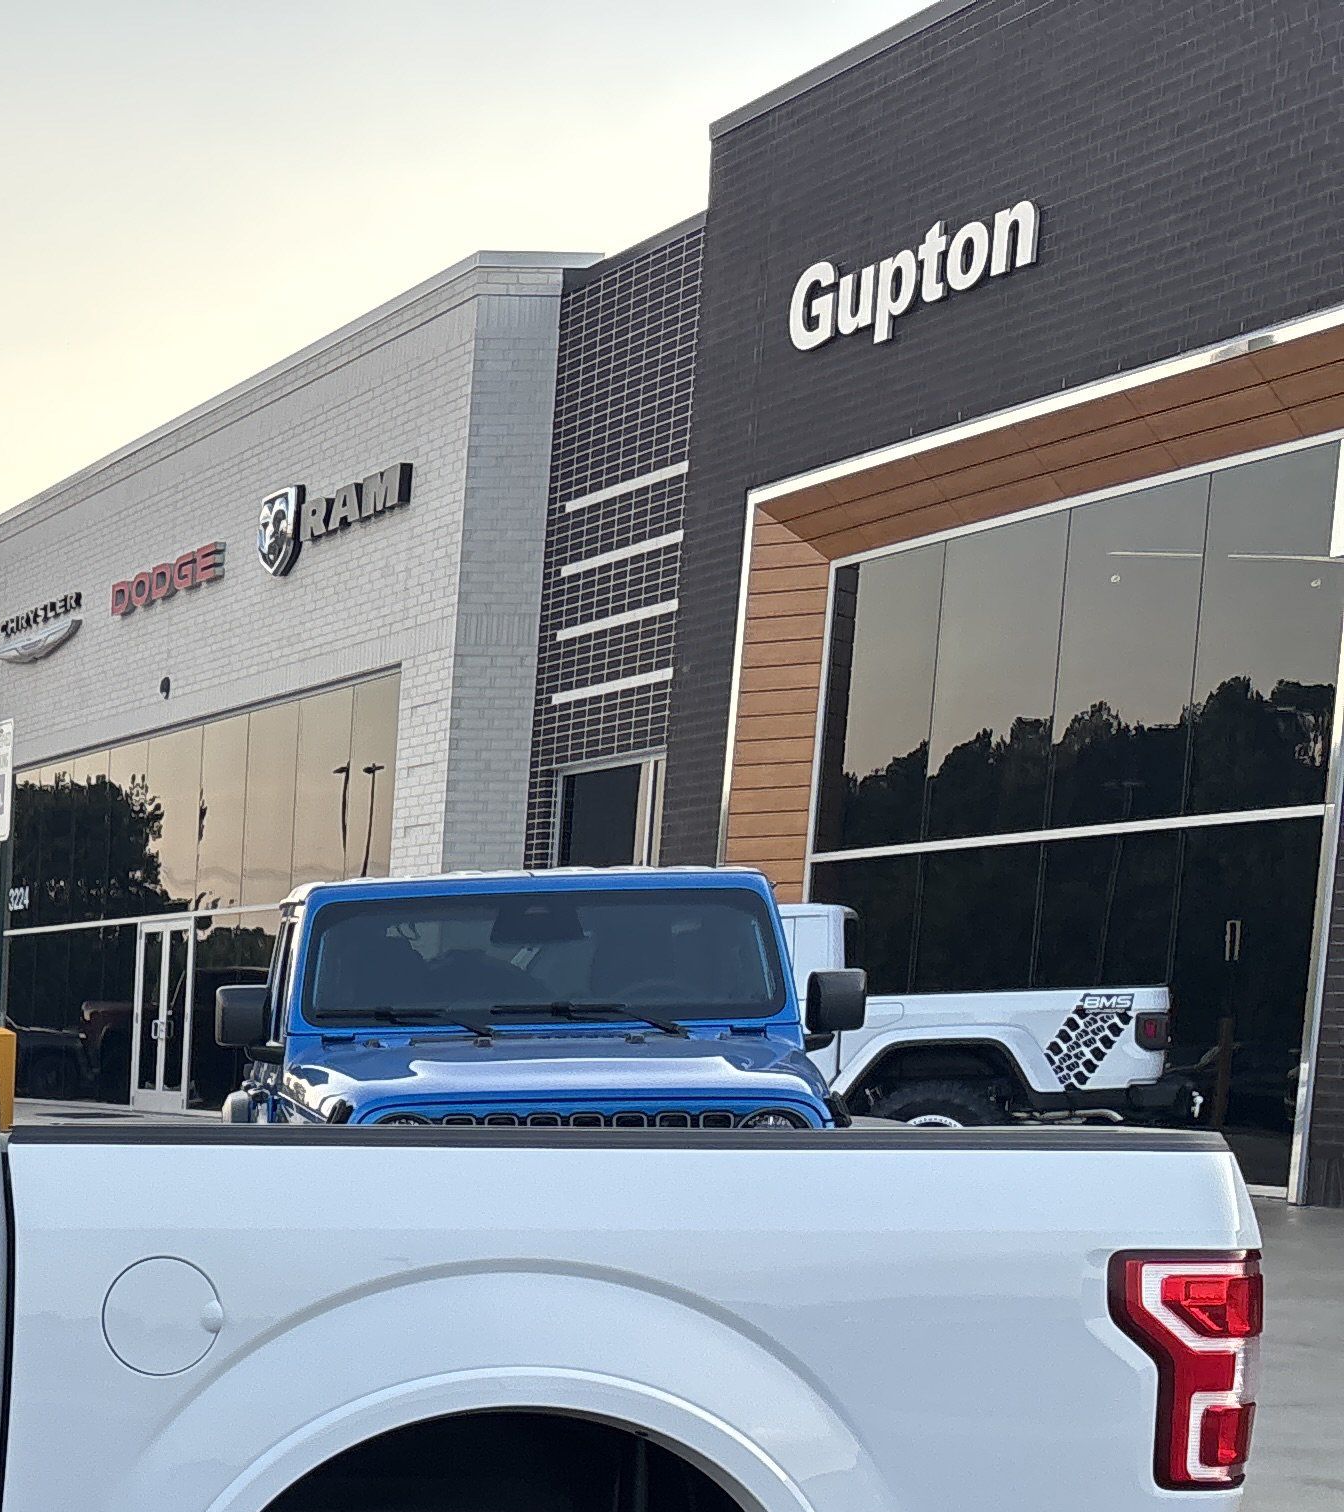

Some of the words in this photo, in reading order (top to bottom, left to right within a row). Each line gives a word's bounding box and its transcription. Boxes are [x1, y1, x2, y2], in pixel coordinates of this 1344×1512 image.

[789, 200, 1040, 351] Gupton
[300, 463, 413, 543] RAM
[111, 541, 226, 616] DODGE
[0, 592, 82, 638] CHRYSLER
[9, 886, 29, 911] 3224
[1084, 995, 1132, 1009] BMS
